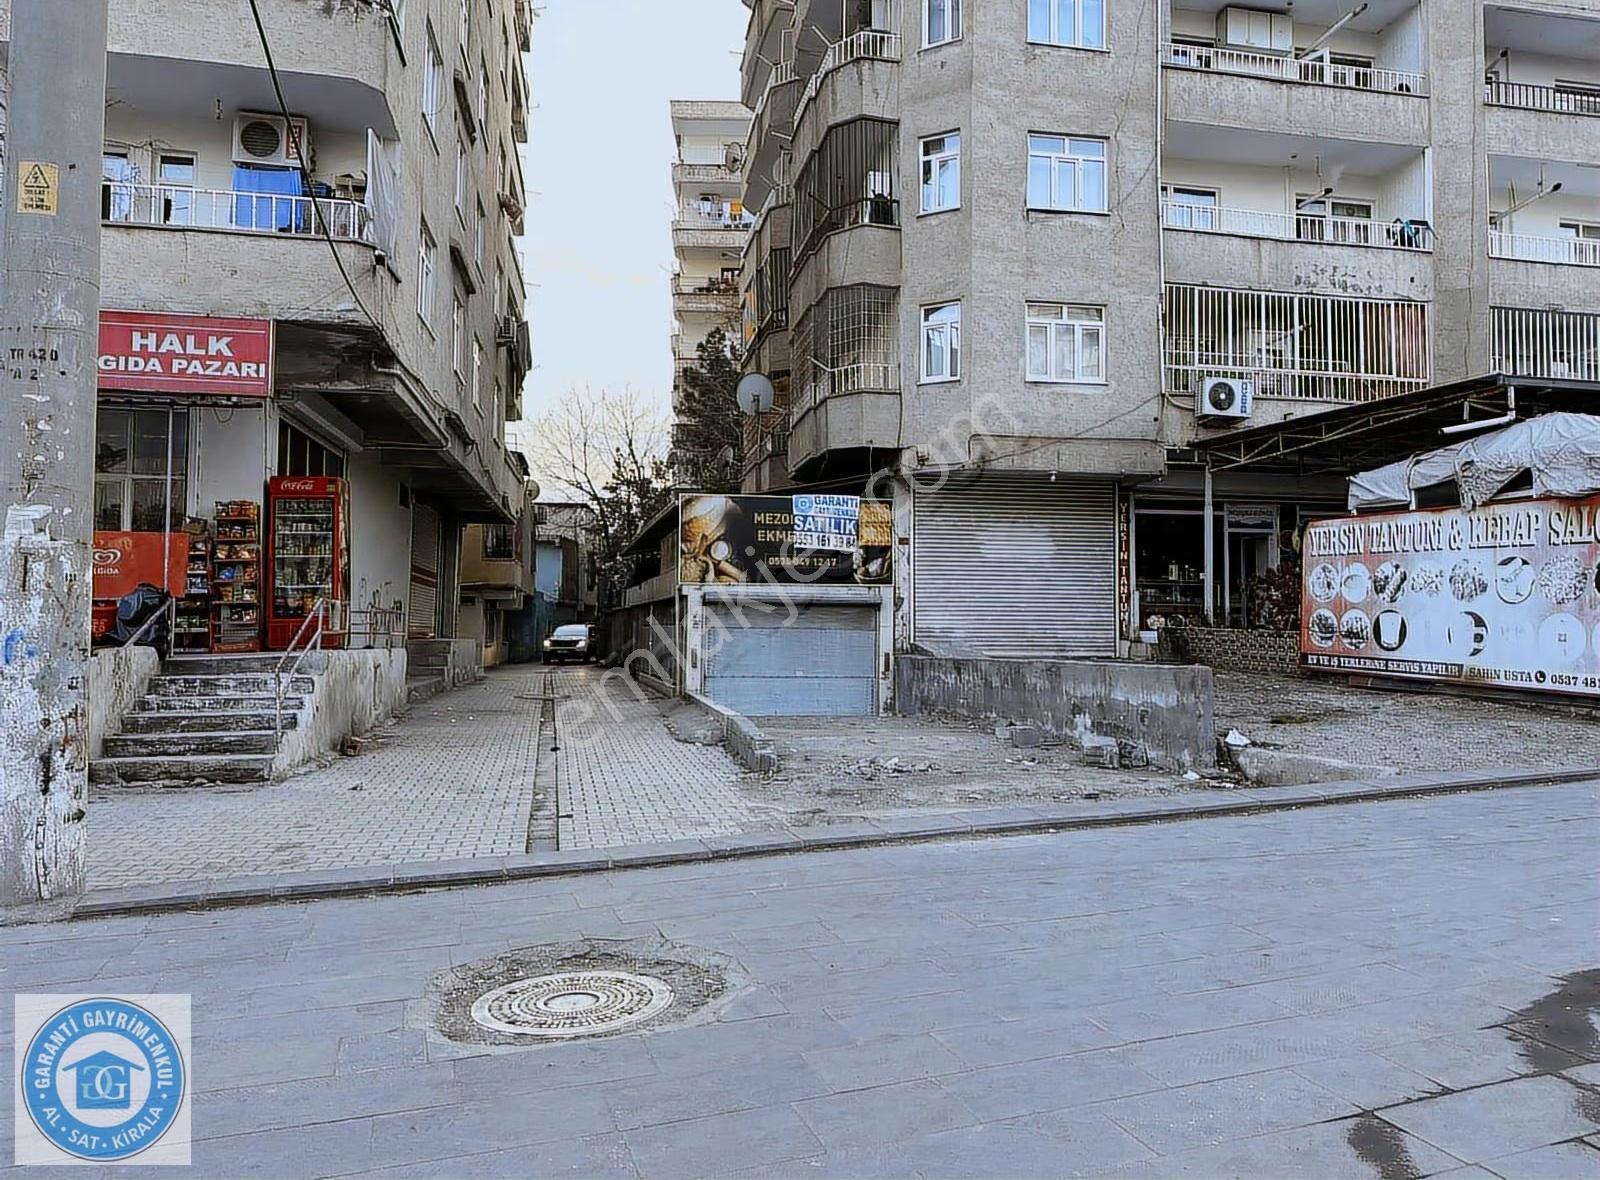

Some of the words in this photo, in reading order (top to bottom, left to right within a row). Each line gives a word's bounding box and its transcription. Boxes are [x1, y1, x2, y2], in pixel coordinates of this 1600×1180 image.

[132, 331, 233, 356] HALK
[98, 355, 163, 373] GIDA
[171, 358, 266, 378] PAZARI
[794, 515, 856, 534] SATILIK
[1468, 510, 1541, 549] KEBAP
[1504, 670, 1532, 683] USTA
[1550, 674, 1579, 686] 0537
